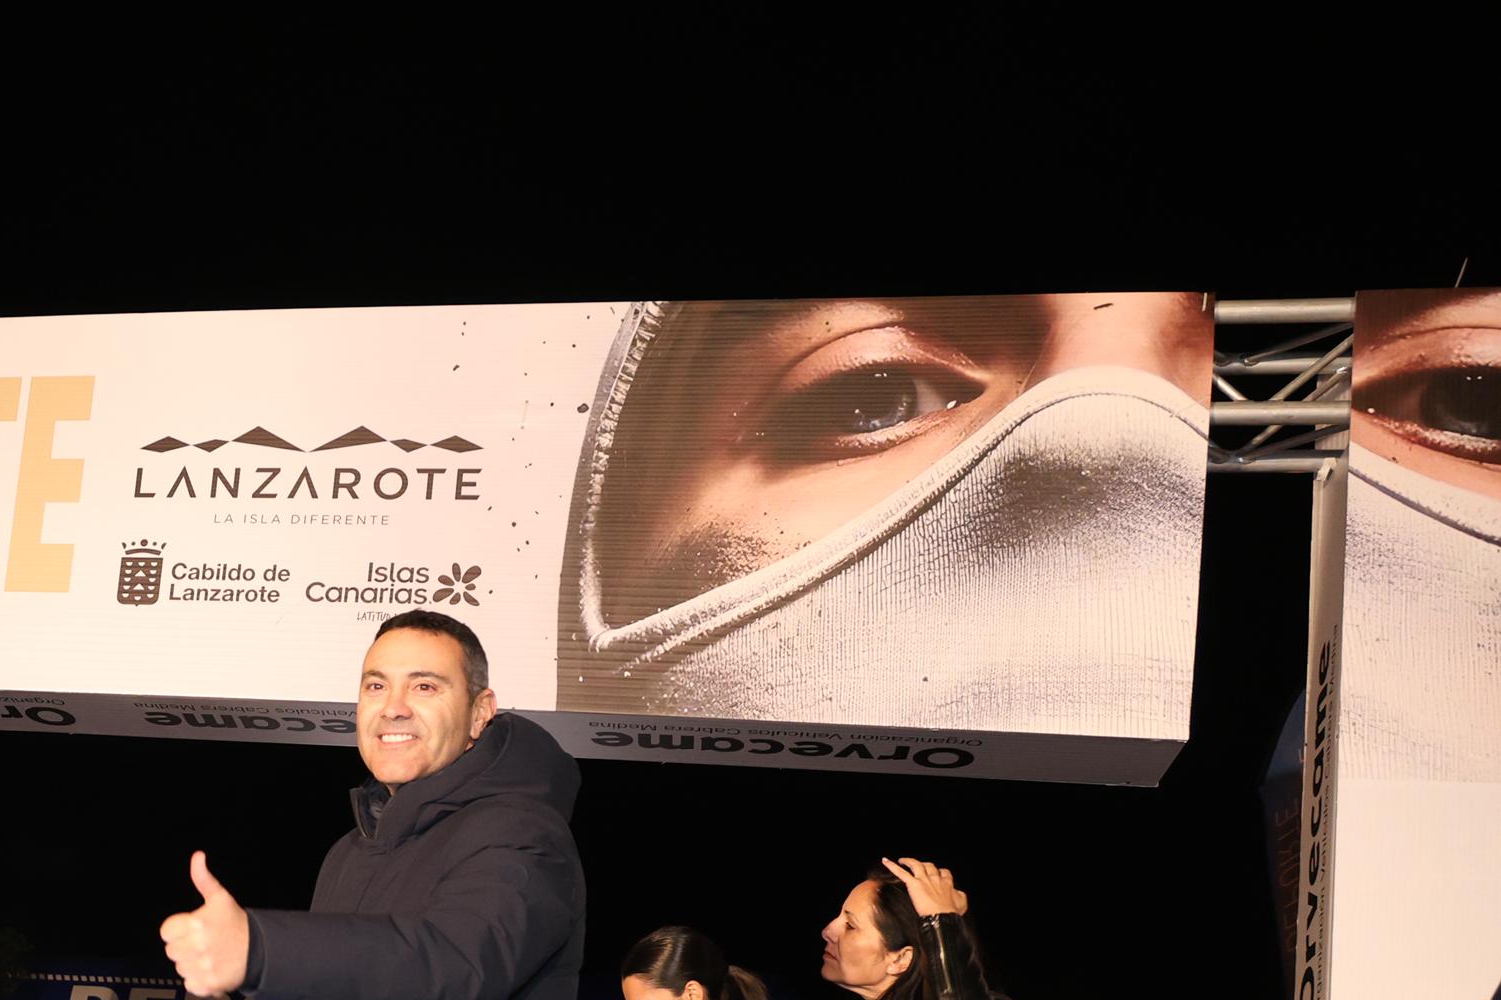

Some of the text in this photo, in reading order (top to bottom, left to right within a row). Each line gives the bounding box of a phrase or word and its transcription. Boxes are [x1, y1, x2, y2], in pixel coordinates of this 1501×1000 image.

[133, 465, 483, 501] LANZAROTE
[214, 513, 390, 526] LA ISLA DIFERENTE
[171, 562, 291, 583] Cabildo de
[367, 562, 430, 583] Islas
[169, 583, 281, 604] Lanzarote
[133, 702, 196, 712] Medina
[201, 703, 269, 714] Cabrera
[143, 711, 357, 734] ecame
[588, 720, 657, 733] Medina
[663, 723, 741, 737] Cabrera
[850, 732, 983, 748] Organización
[590, 731, 975, 769] Orvecame
